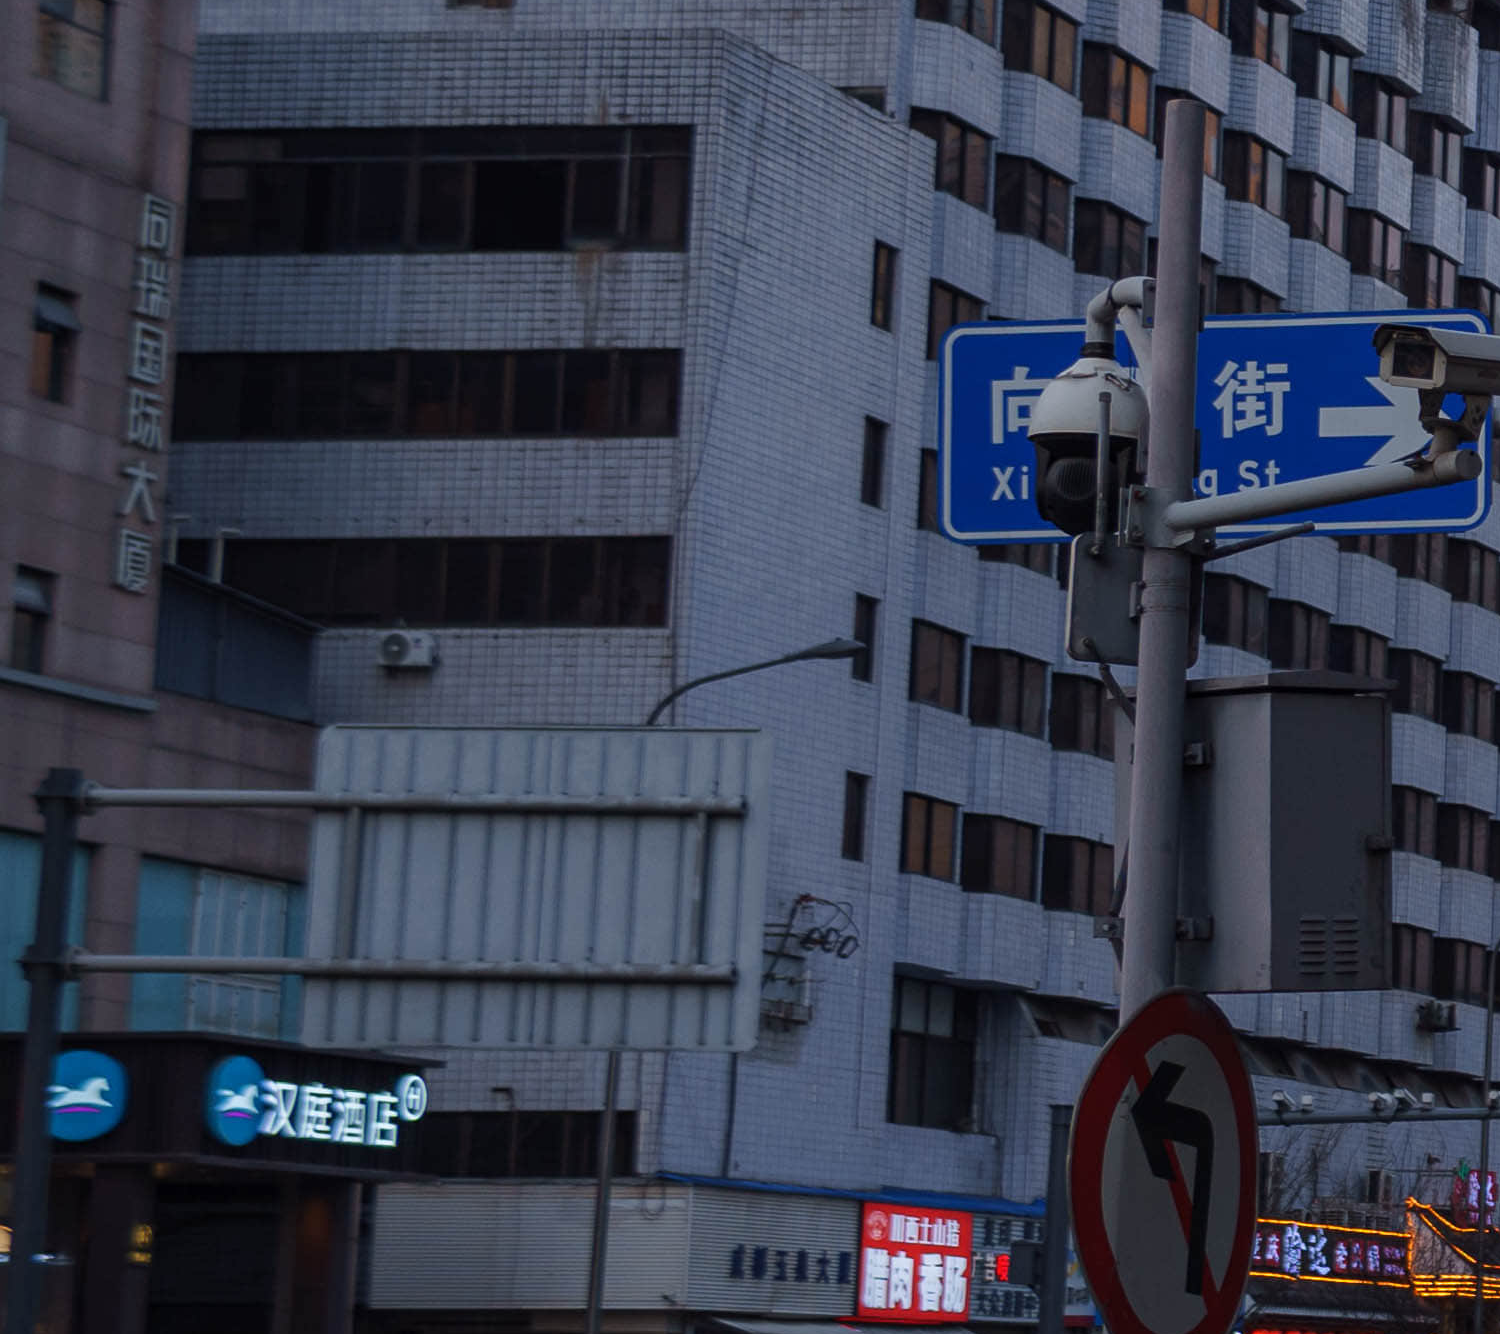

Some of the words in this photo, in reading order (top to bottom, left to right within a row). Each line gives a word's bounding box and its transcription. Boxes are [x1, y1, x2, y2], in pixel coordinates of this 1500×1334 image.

[113, 192, 173, 594] 同瑞国际大厦
[991, 360, 1291, 444] 向街
[1238, 458, 1281, 489] St
[258, 1079, 398, 1148] 汉庭酒店
[862, 1247, 914, 1310] 腊肉
[918, 1253, 968, 1314] 香肠
